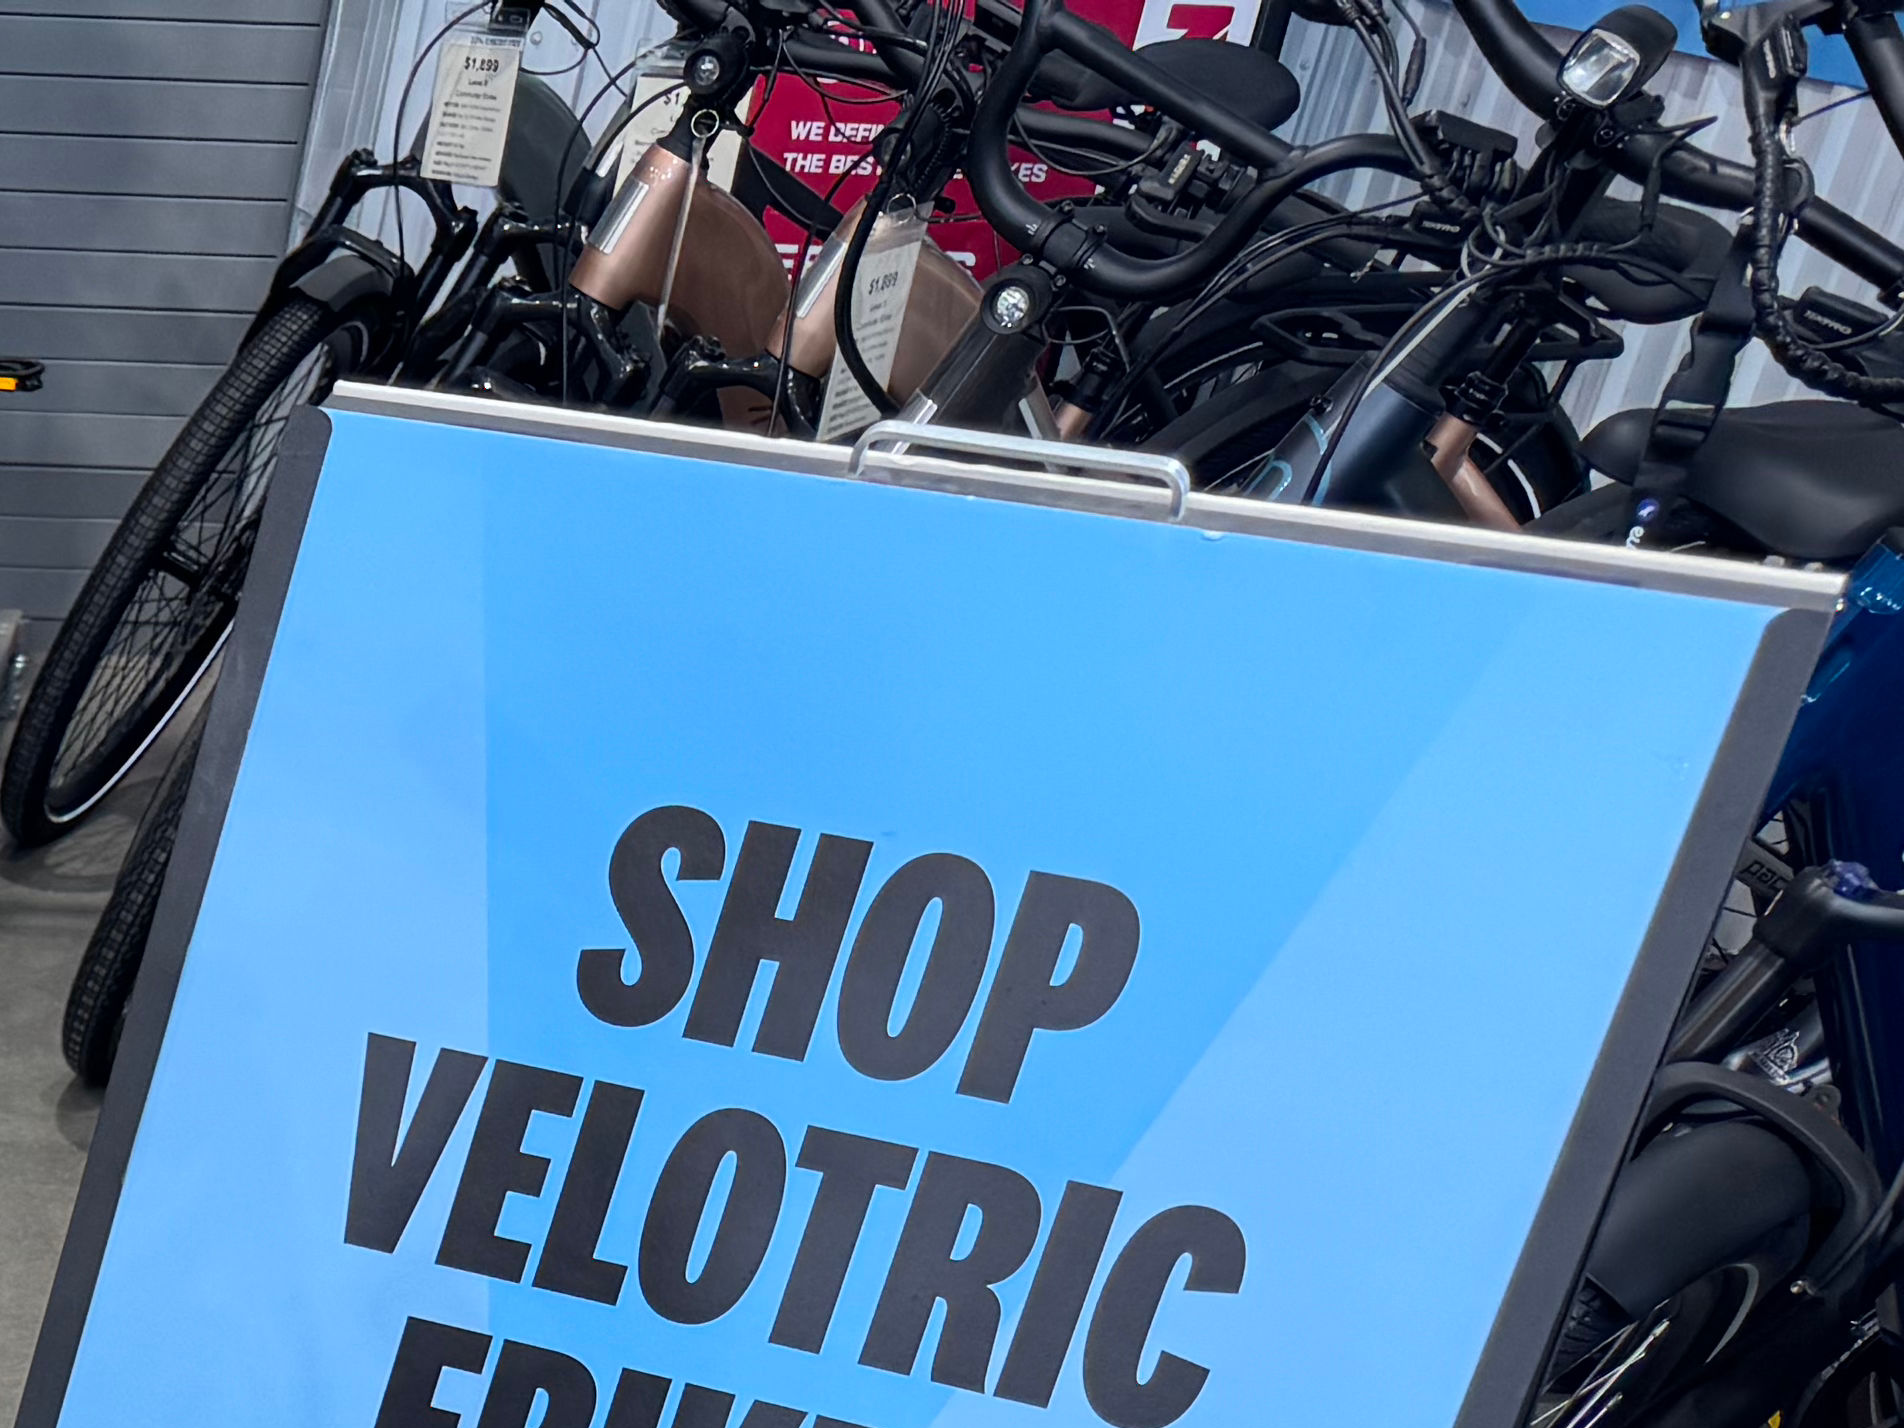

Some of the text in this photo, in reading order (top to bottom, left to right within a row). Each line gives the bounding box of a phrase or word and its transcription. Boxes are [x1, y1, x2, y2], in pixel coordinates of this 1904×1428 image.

[791, 120, 826, 142] WE
[784, 153, 826, 174] THE
[577, 805, 1140, 1104] SHOP
